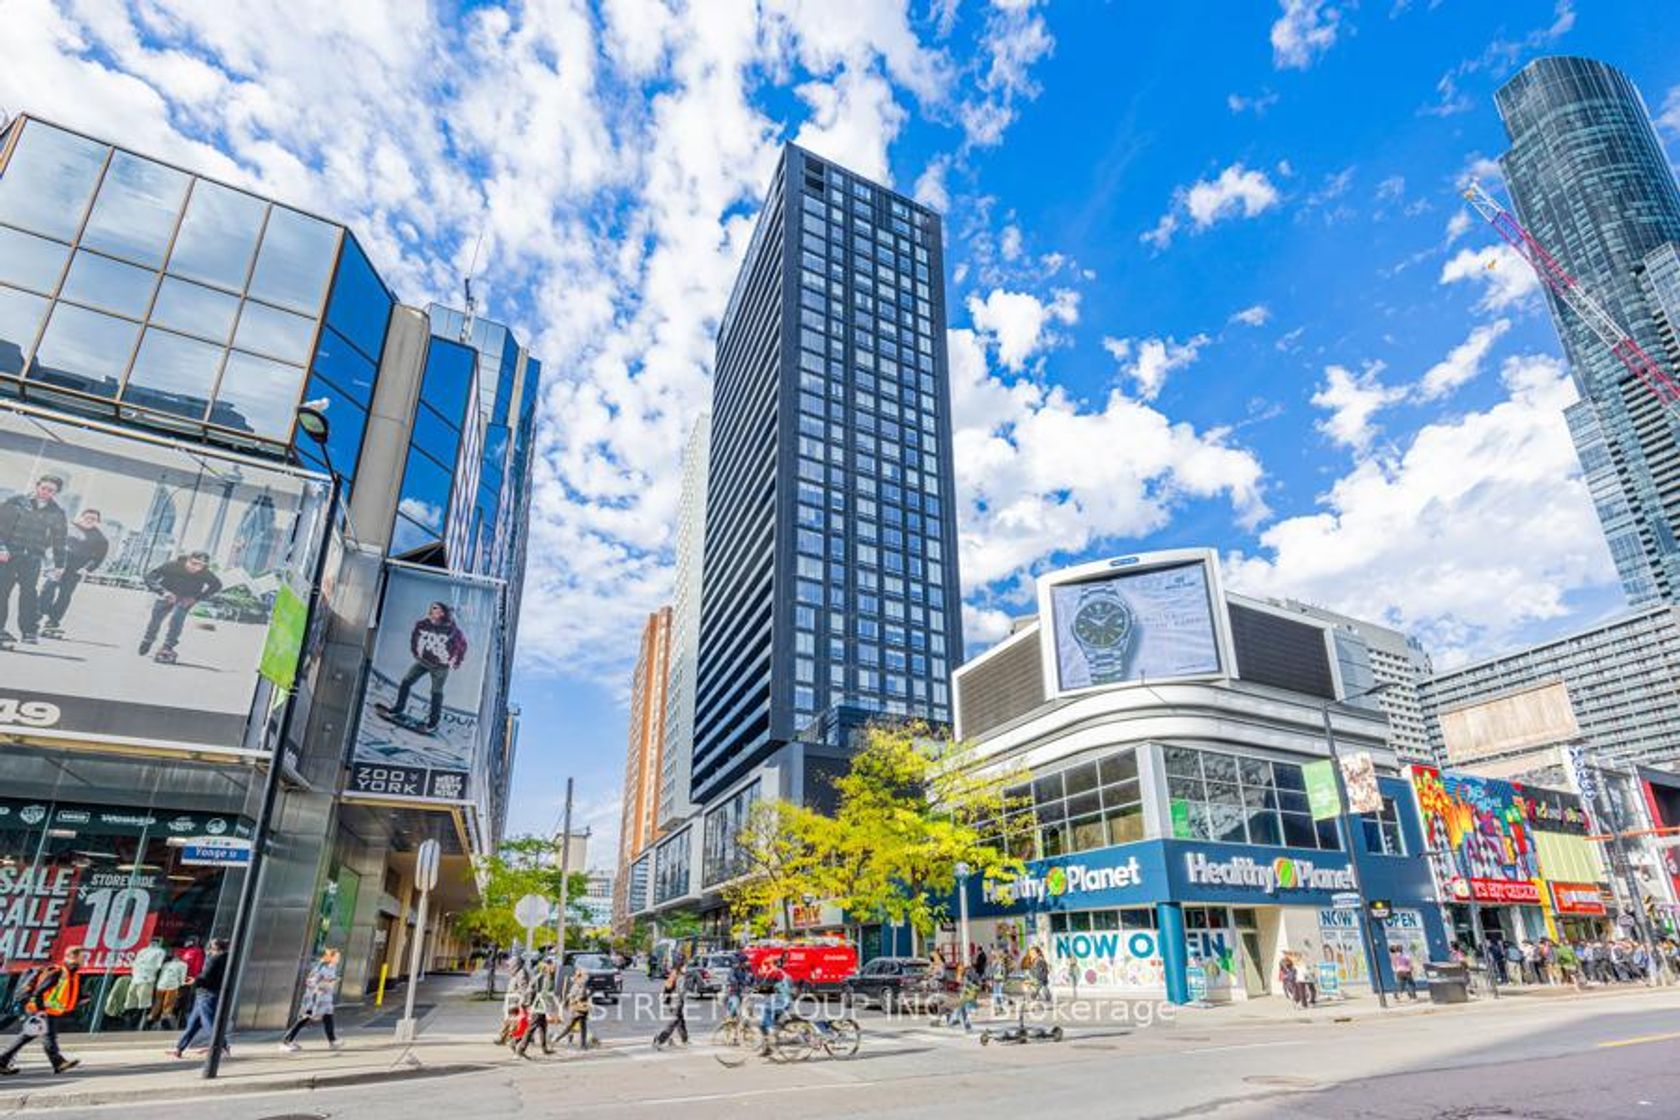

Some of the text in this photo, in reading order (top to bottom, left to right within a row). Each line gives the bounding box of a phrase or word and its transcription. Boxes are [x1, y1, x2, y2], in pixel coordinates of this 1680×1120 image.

[357, 767, 406, 782] ZOO
[357, 779, 417, 795] YORK
[0, 866, 74, 896] SALE
[1066, 856, 1143, 893] Planet
[1185, 852, 1358, 893] Healthy Planet
[1321, 910, 1353, 926] NOW
[1386, 911, 1417, 927] OPEN
[1057, 933, 1119, 960] NOW
